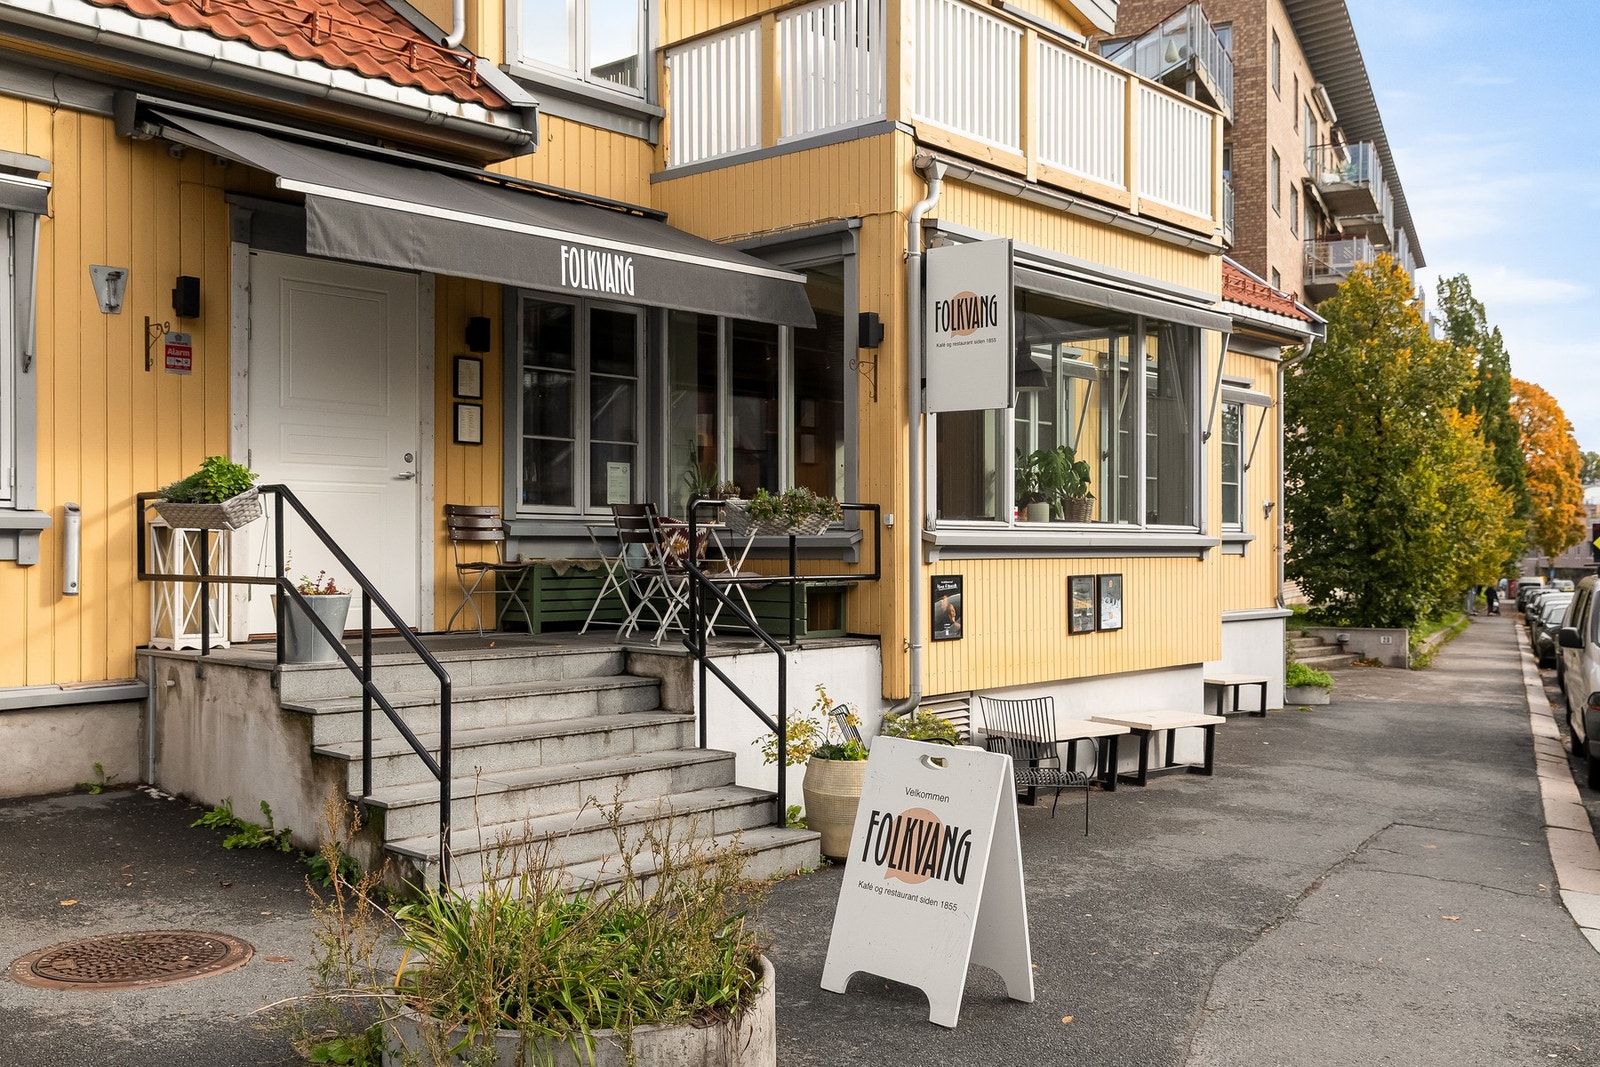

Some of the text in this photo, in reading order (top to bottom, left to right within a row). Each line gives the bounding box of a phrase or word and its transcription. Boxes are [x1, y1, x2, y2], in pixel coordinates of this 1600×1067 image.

[560, 244, 635, 296] FOLKVANG
[935, 294, 998, 333] FOLKVANG
[167, 347, 190, 357] Alarm
[905, 787, 950, 803] Velkommen
[861, 810, 972, 885] FOLKVANG
[858, 880, 958, 912] Kafé og restaurant siden 1855
